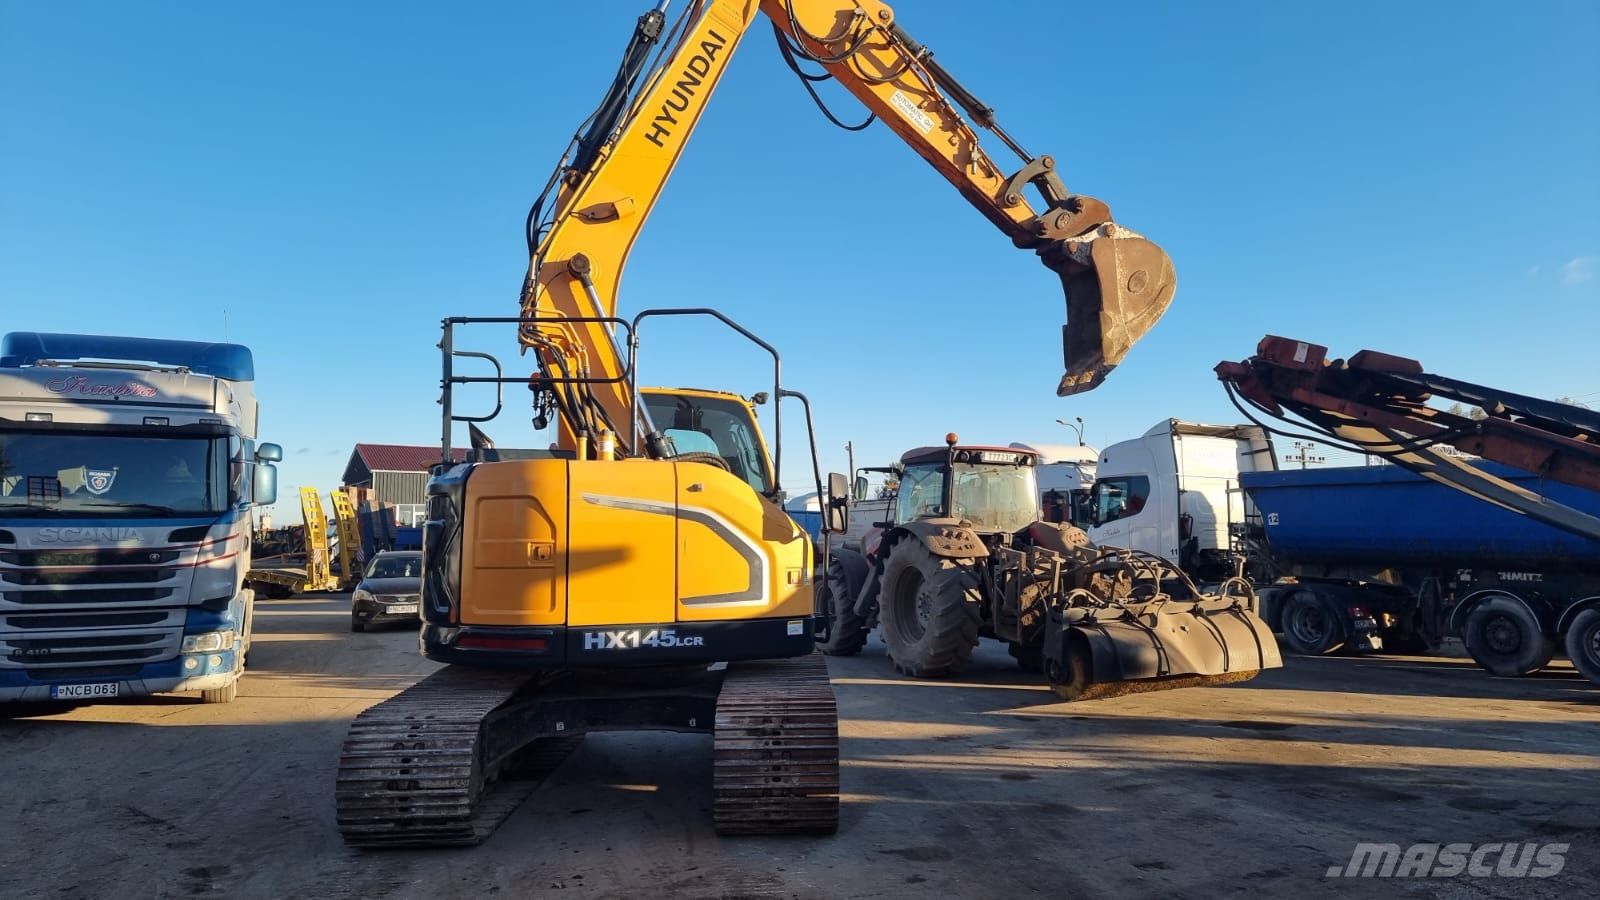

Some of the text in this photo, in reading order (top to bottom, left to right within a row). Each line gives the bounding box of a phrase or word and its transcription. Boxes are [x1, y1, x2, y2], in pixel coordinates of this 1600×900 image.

[644, 29, 727, 148] HYUNDAI
[1269, 514, 1279, 523] 12
[40, 527, 144, 543] SCANIA
[1170, 548, 1178, 556] 11
[65, 684, 117, 697] NCB 063
